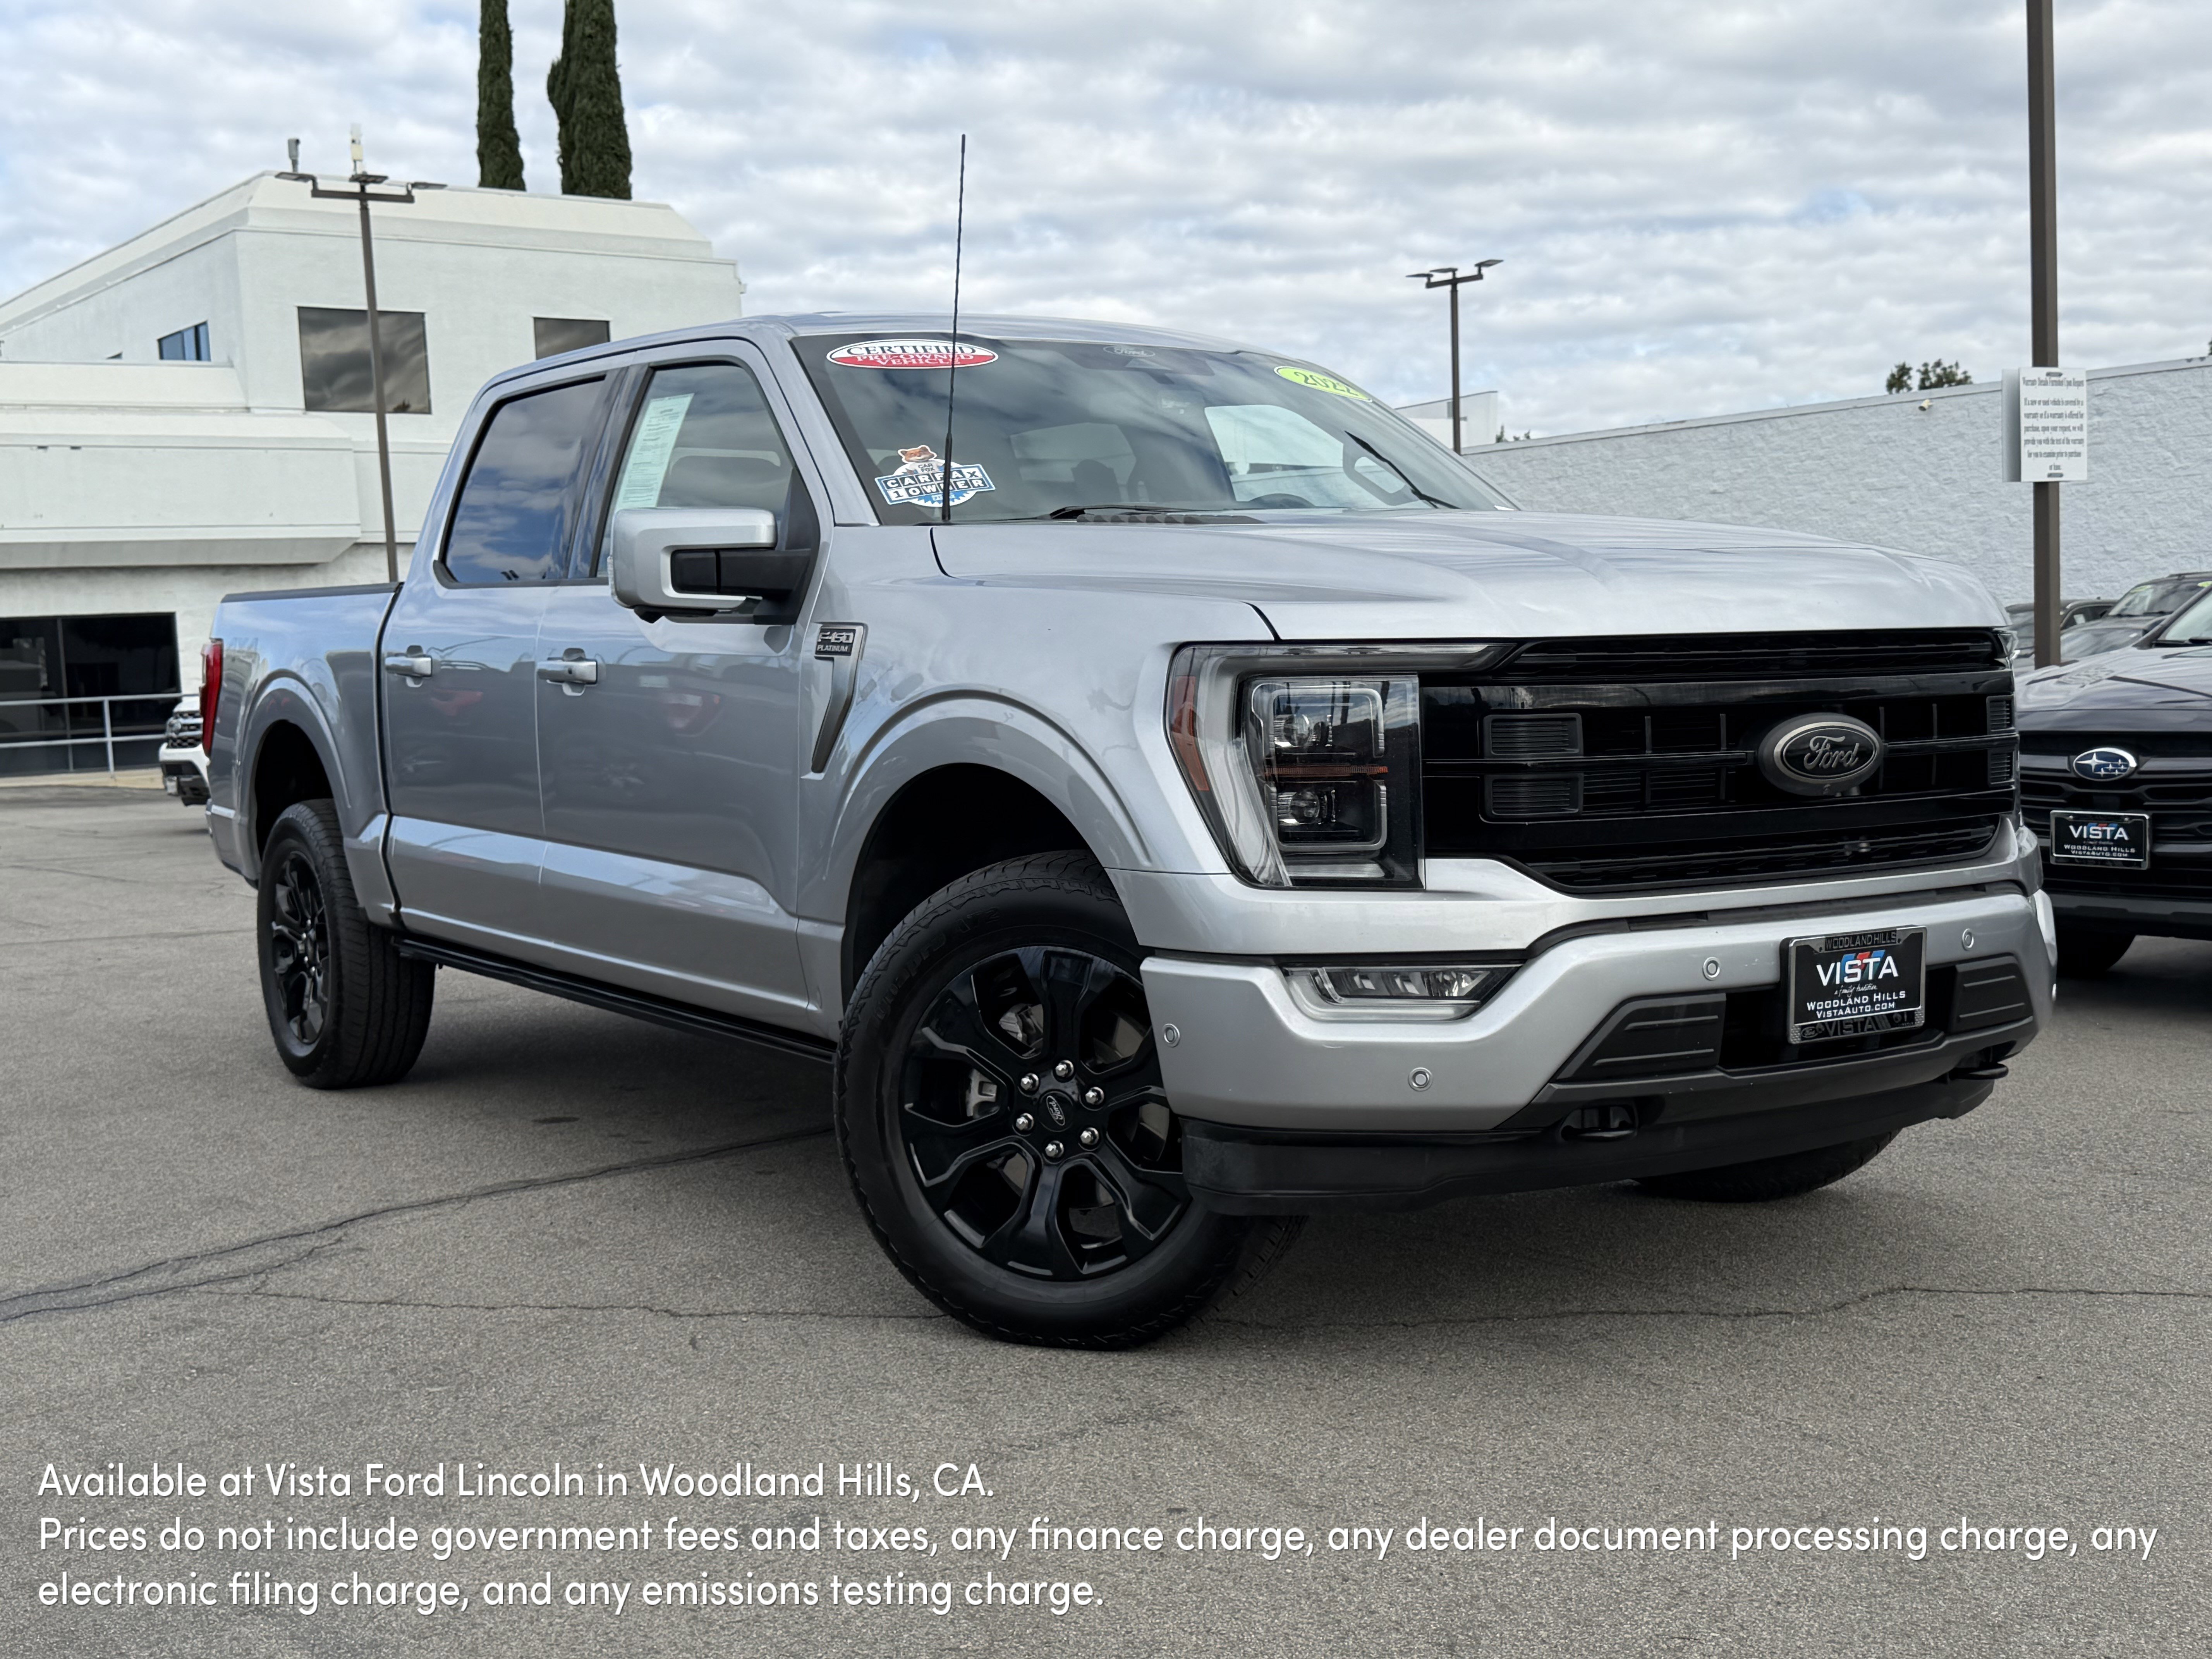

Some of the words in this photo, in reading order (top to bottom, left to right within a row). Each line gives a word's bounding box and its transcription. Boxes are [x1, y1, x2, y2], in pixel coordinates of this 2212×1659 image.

[847, 345, 976, 355] CERTIFIED
[876, 357, 961, 366] VEHICLE
[886, 469, 980, 488] CARFAX
[892, 489, 904, 498] 1
[1803, 735, 1860, 770] Ford
[2069, 825, 2129, 841] VISTA
[1825, 934, 1873, 950] WOODLAND
[1873, 931, 1896, 945] HILLS
[1816, 955, 1899, 986] VISTA
[1825, 1016, 1877, 1037] VISTA
